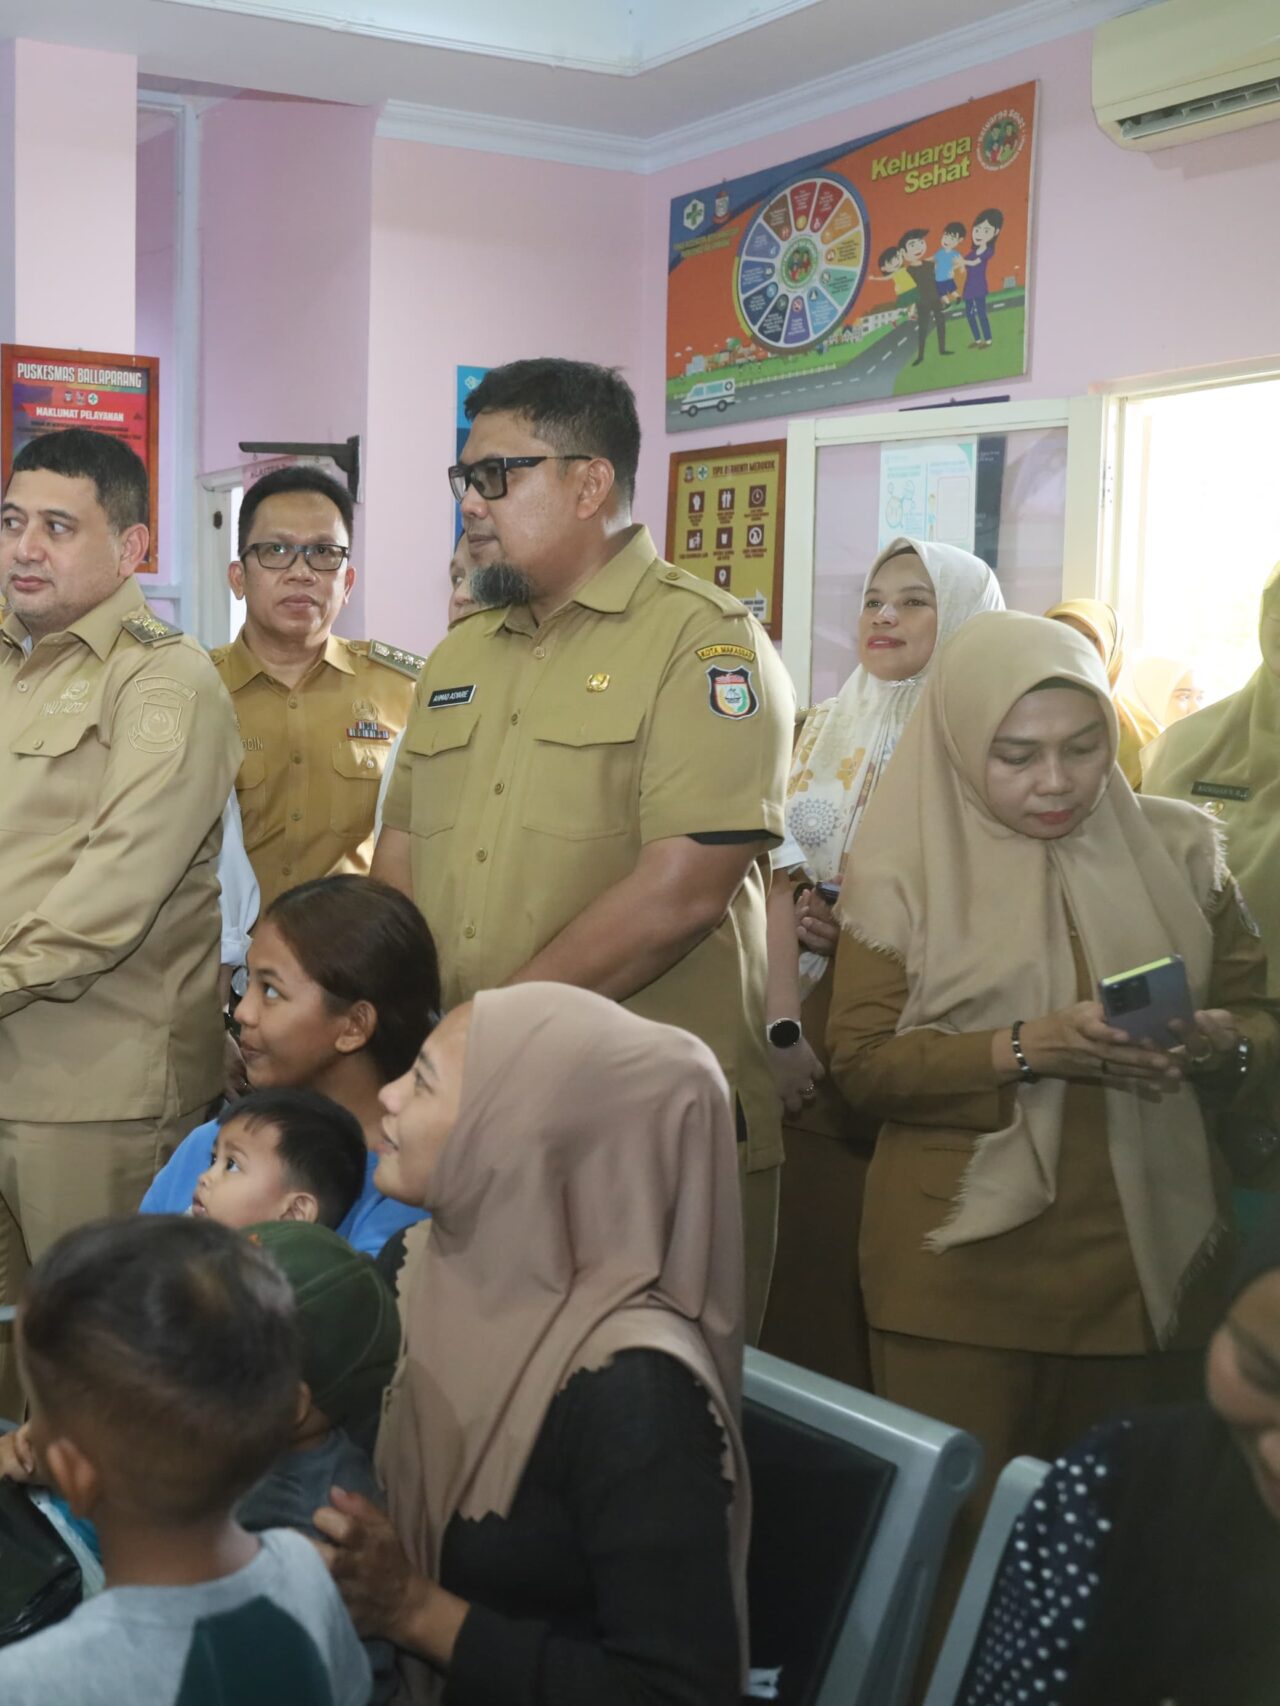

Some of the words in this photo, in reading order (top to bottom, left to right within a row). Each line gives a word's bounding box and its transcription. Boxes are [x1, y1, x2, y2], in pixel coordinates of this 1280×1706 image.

[872, 136, 971, 181] Keluarga
[904, 156, 970, 193] Sehat
[17, 363, 75, 382] PUSKESMAS
[78, 367, 142, 388] BALLAPARANG
[36, 407, 79, 419] MAKLUMAT
[80, 410, 124, 422] PELAYANAN
